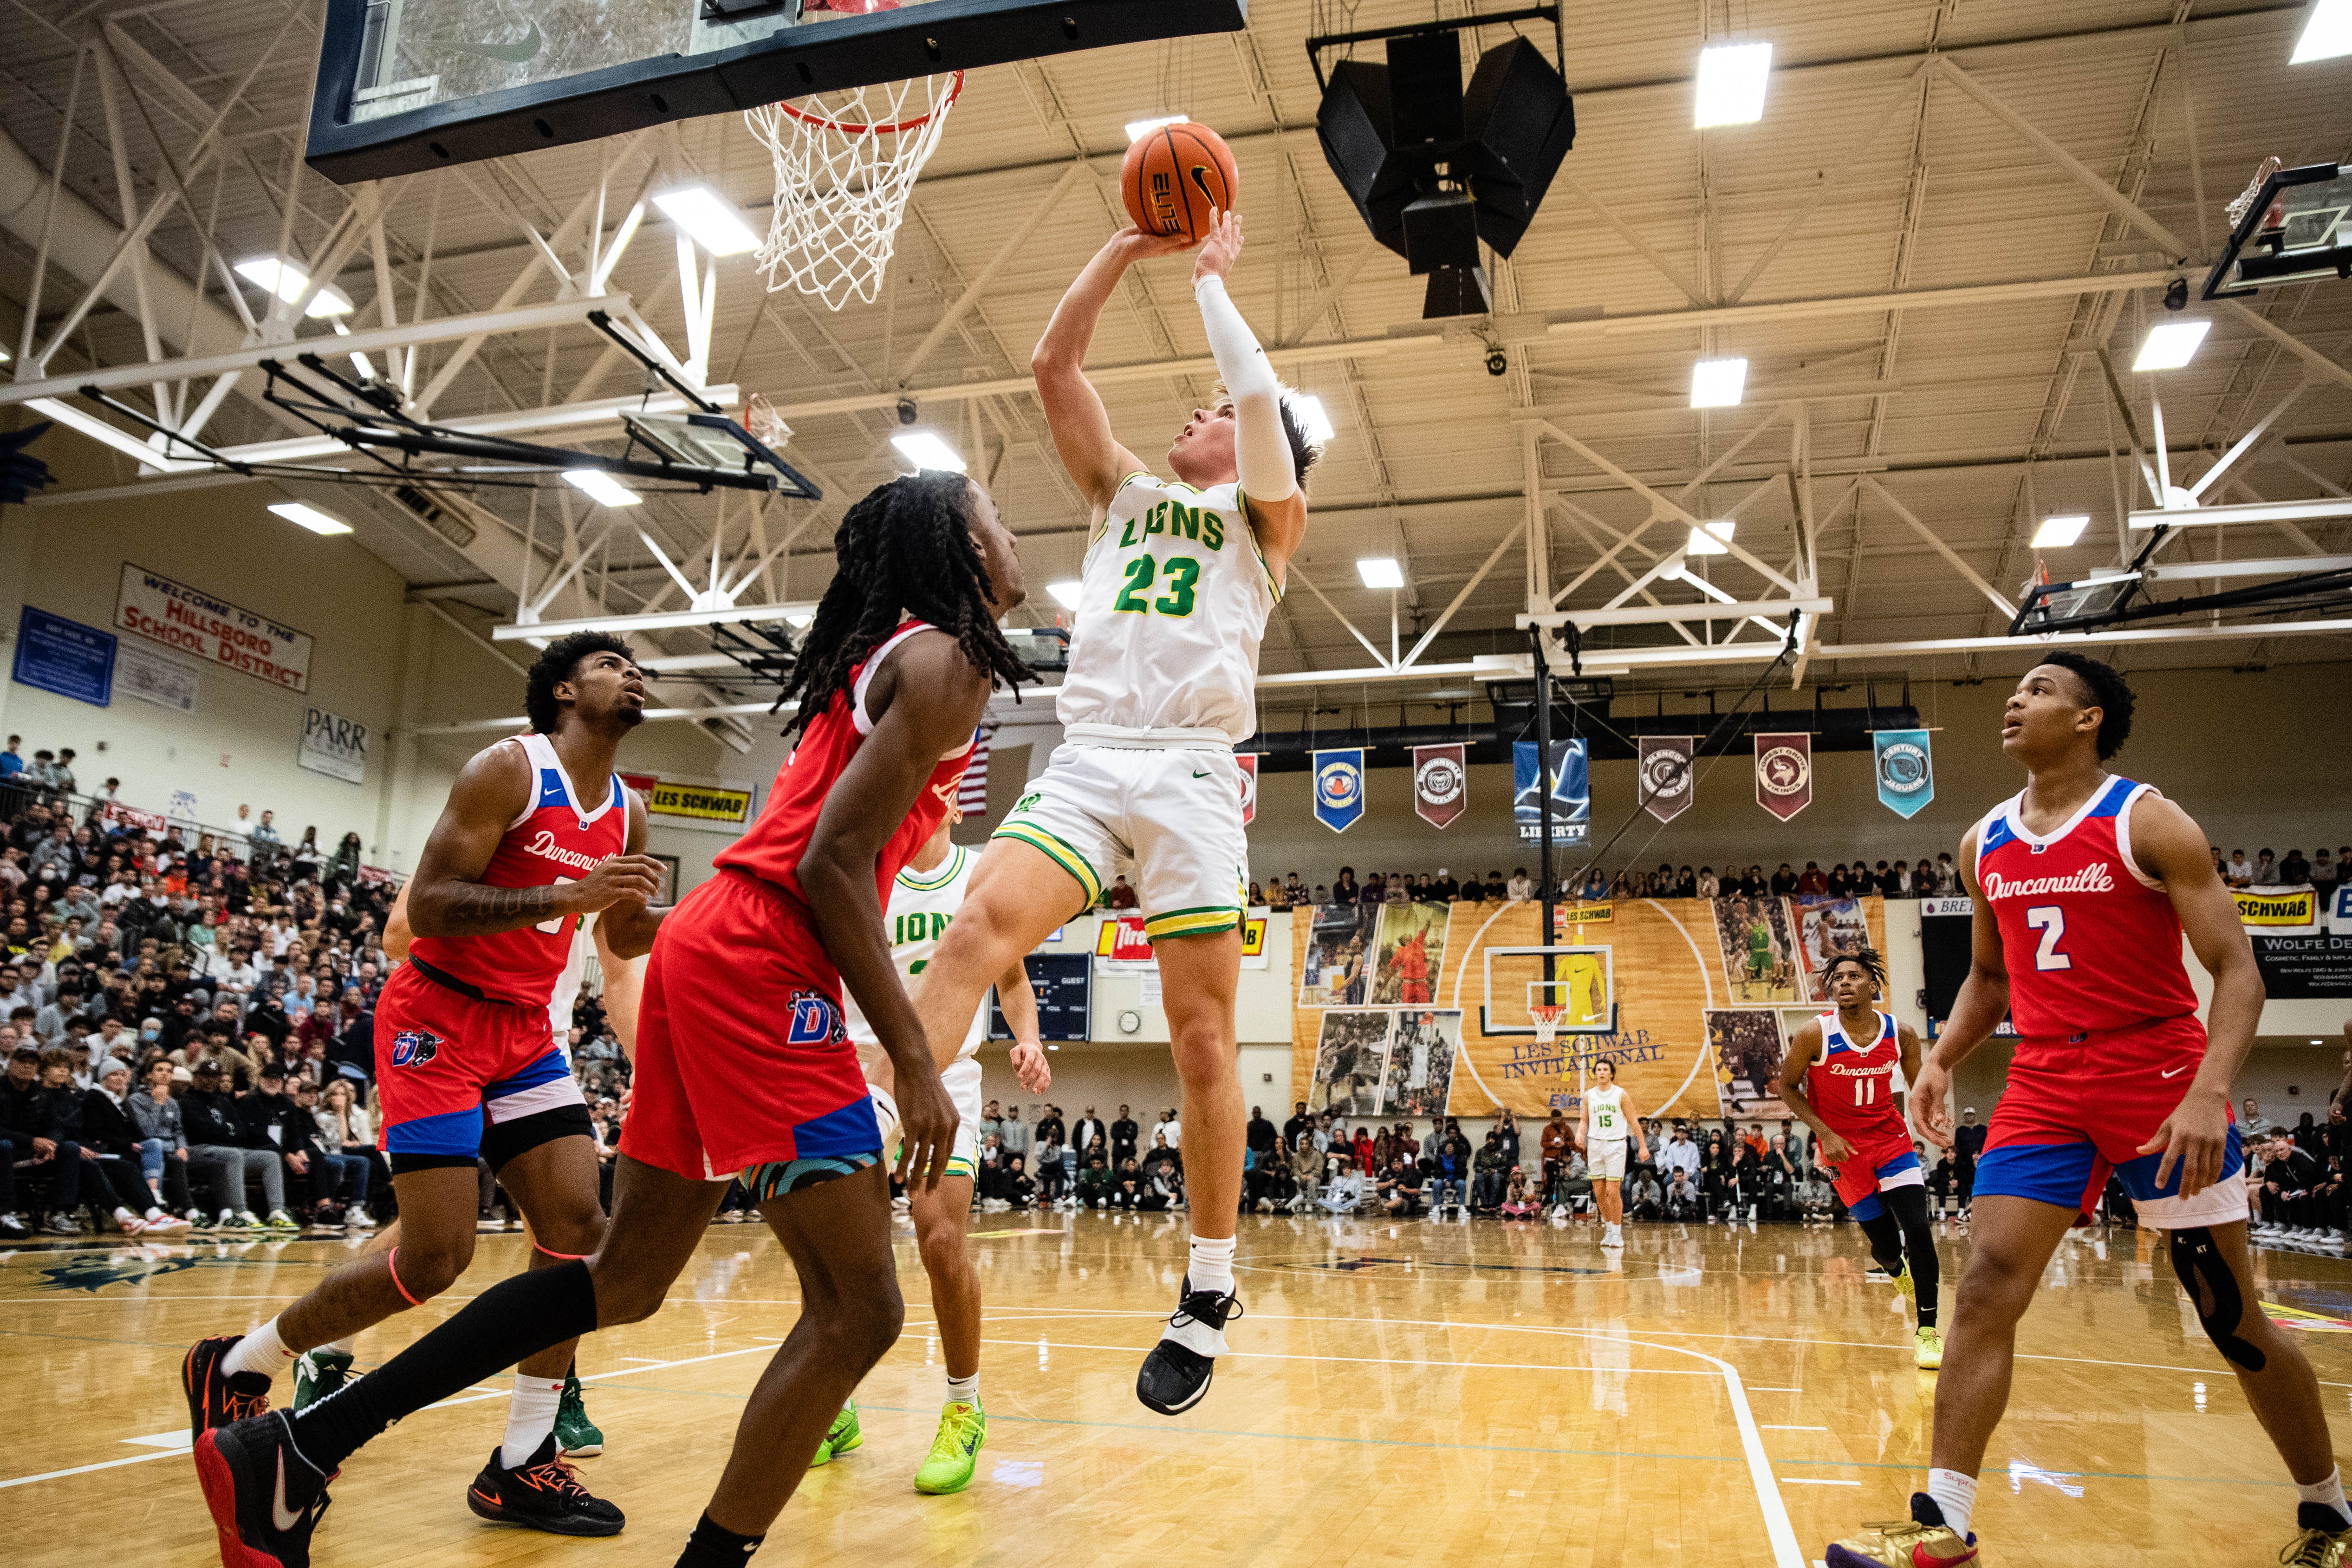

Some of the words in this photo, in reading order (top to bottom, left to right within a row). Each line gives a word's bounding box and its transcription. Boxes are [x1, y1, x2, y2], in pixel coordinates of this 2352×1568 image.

[1153, 172, 1182, 233] ELITE
[1118, 500, 1224, 551] LIONS
[1112, 553, 1201, 618] 23
[144, 575, 229, 616] WELCOME
[238, 612, 259, 628] TO
[267, 624, 295, 643] THE
[165, 599, 272, 656] HILLSBORO
[124, 605, 206, 653] SCHOOL
[218, 640, 302, 687] DISTRICT
[306, 708, 365, 753] PARR
[1761, 748, 1782, 772] FOREST
[1787, 748, 1806, 771] GROVE
[654, 790, 678, 807] LES
[681, 793, 742, 813] SCHWAB
[1767, 782, 1801, 793] VIKINGS
[1985, 862, 2115, 901] Duncanville
[1566, 911, 1578, 921] LES
[1579, 908, 1611, 920] SCHWAB
[2237, 900, 2307, 917] SCHWAB
[1116, 922, 1146, 950] Tire
[2026, 904, 2073, 972] 2
[1512, 1042, 1552, 1060] LES
[1560, 1029, 1650, 1054] SCHWAB
[1501, 1046, 1664, 1079] INVITATIONAL
[1830, 1060, 1895, 1076] Duncanvill
[1854, 1077, 1875, 1106] 11
[1593, 1103, 1616, 1113] LIONS
[1598, 1115, 1612, 1127] 15
[2196, 1244, 2207, 1254] KT
